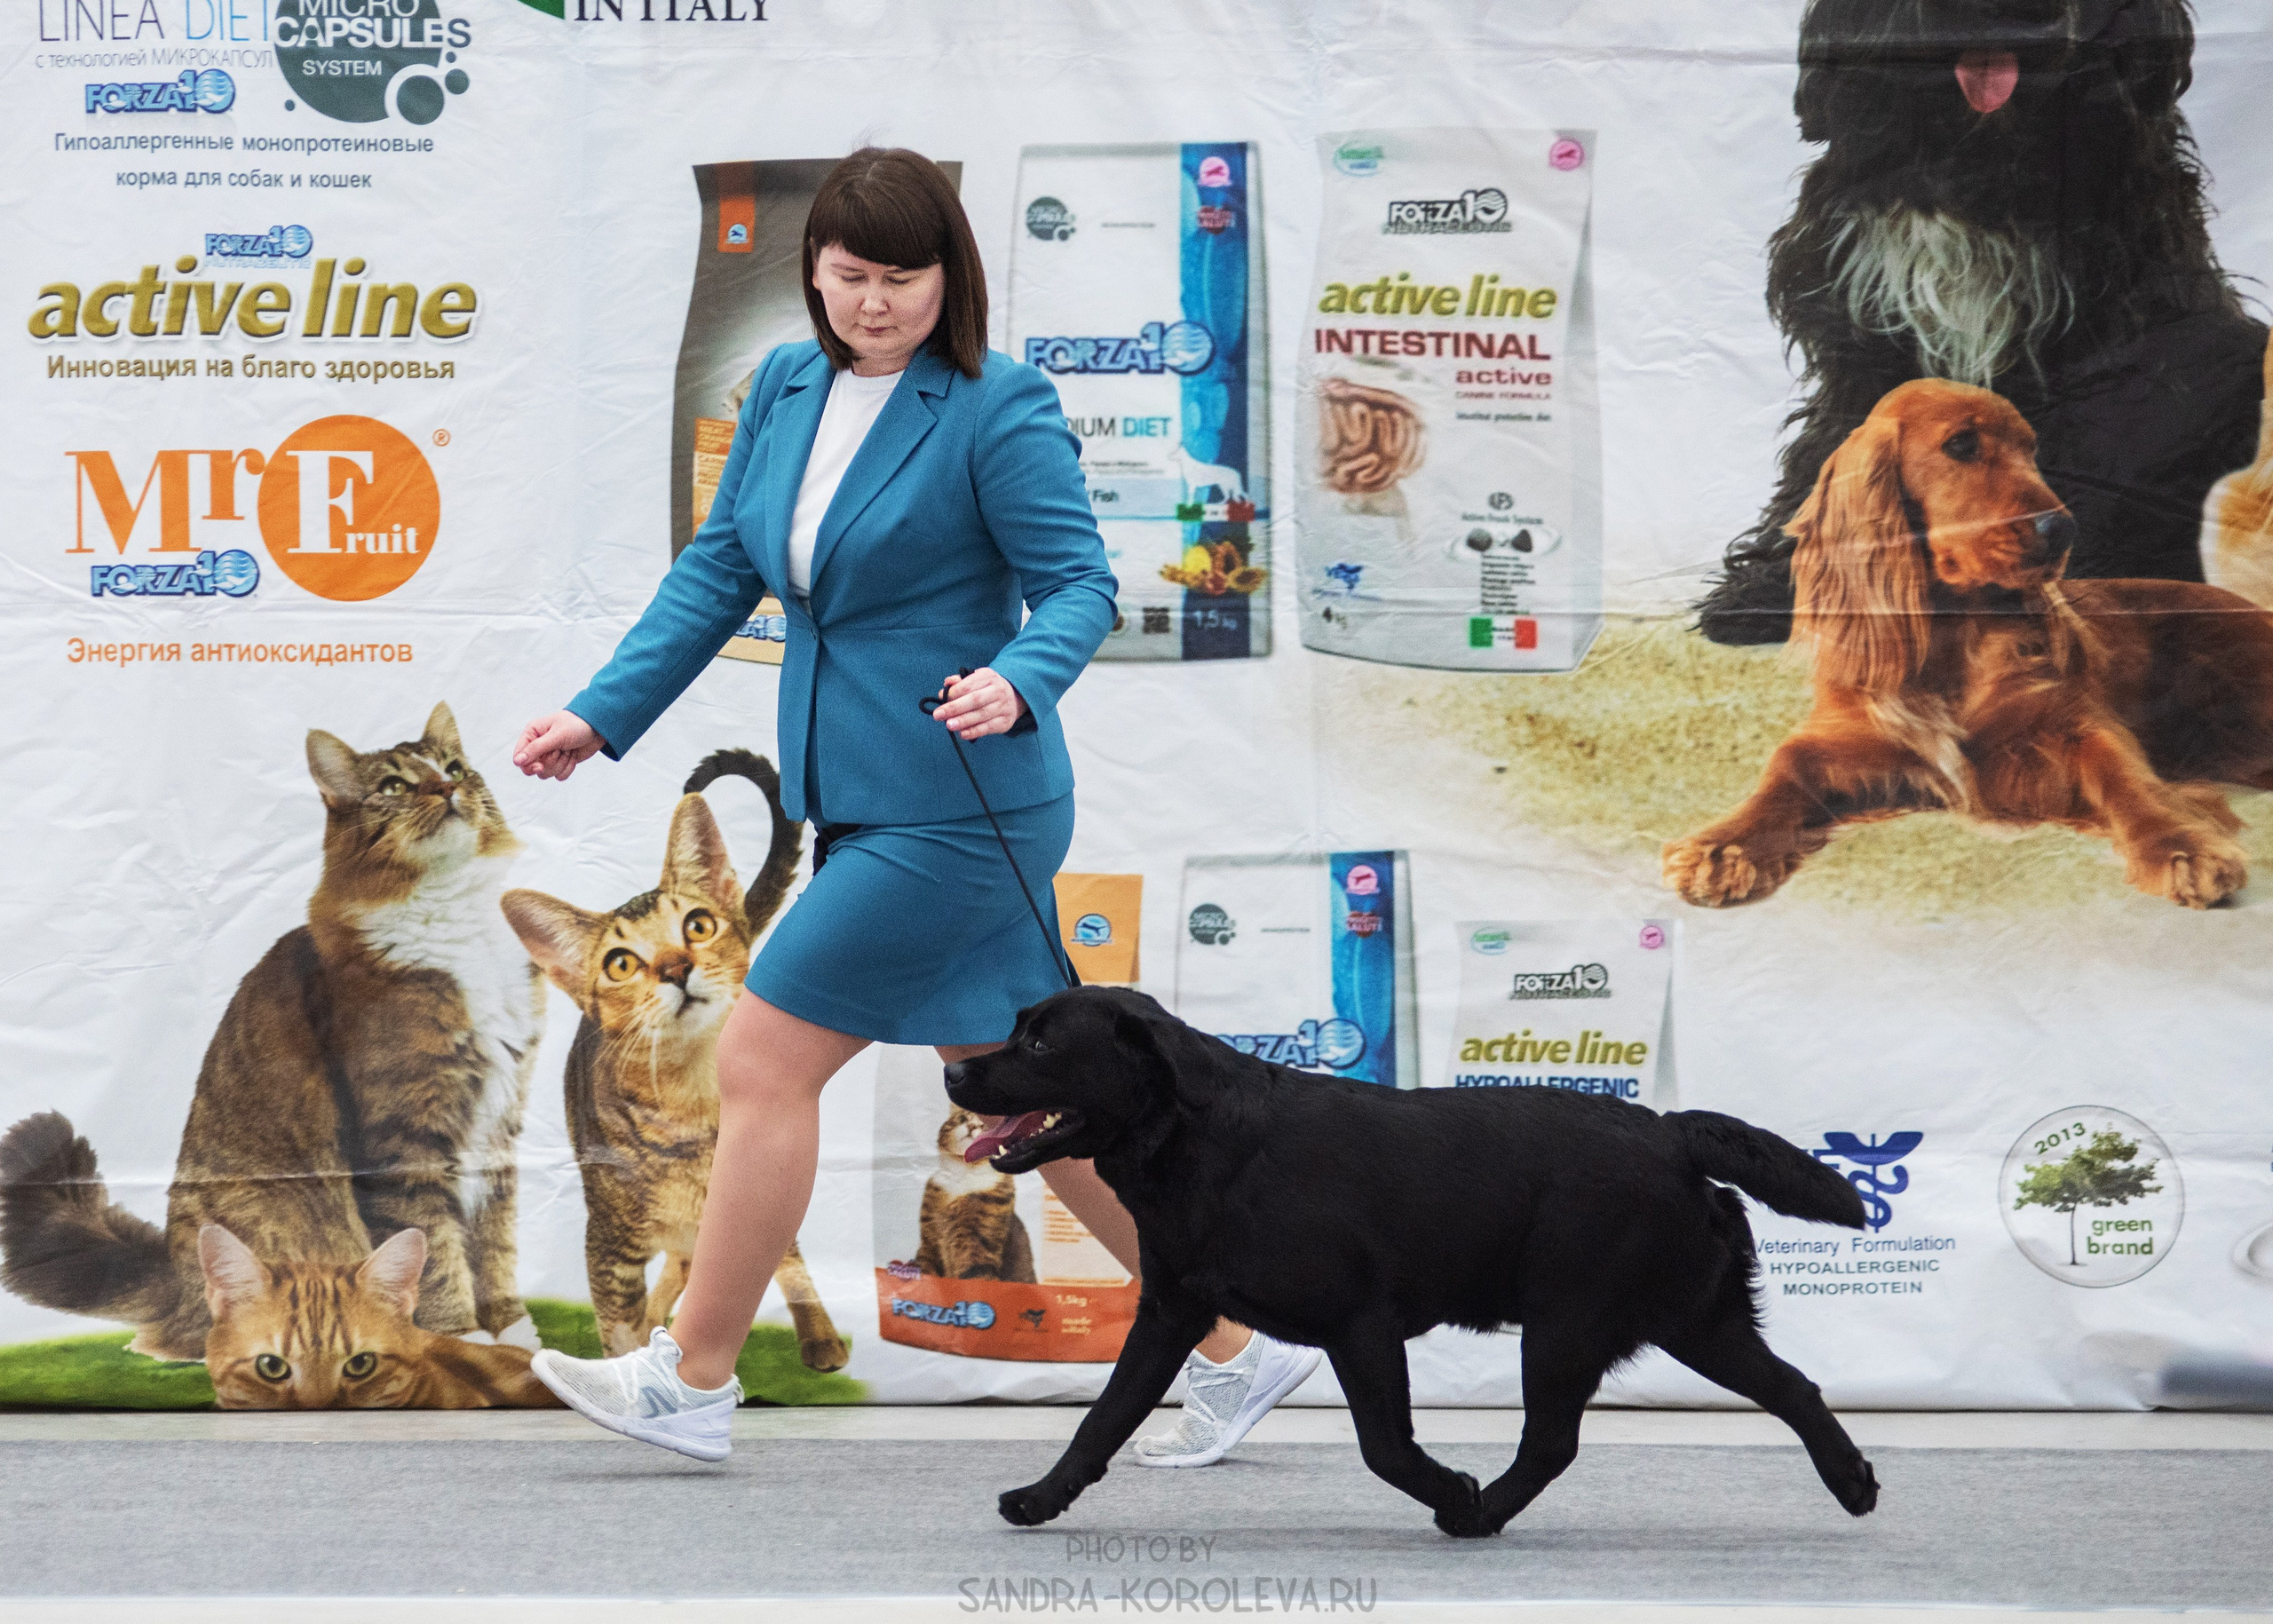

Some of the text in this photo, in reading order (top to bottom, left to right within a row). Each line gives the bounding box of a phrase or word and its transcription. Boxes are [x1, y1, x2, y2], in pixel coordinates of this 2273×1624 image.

[298, 0, 420, 17] MICRO
[574, 0, 623, 21] IN
[40, 0, 165, 41] LINEA
[274, 16, 472, 48] CAPSULES
[49, 49, 147, 67] технологией
[151, 48, 273, 68] МИКРОКАПСУЛ
[302, 59, 383, 75] SYSTEM
[54, 132, 434, 155] Гипоаллергенные монопротеиновые
[116, 169, 372, 191] корма для собак и кошек
[27, 255, 478, 340] active line
[1318, 272, 1558, 320] active line
[1314, 329, 1553, 361] INTESTINAL
[47, 355, 455, 384] Инновация на благо здоровья
[1455, 367, 1553, 385] active
[1122, 416, 1172, 437] DIET
[67, 638, 414, 667] Энергия антиоксидантов
[1460, 1028, 1649, 1066] active line
[2034, 1121, 2086, 1155] 2013
[2091, 1219, 2152, 1237] green
[1852, 1235, 1956, 1253] Formulation
[2087, 1236, 2153, 1255] brand
[1770, 1259, 1940, 1275] HYPOALLERGENIC
[1783, 1281, 1923, 1296] MONOPROTEIN
